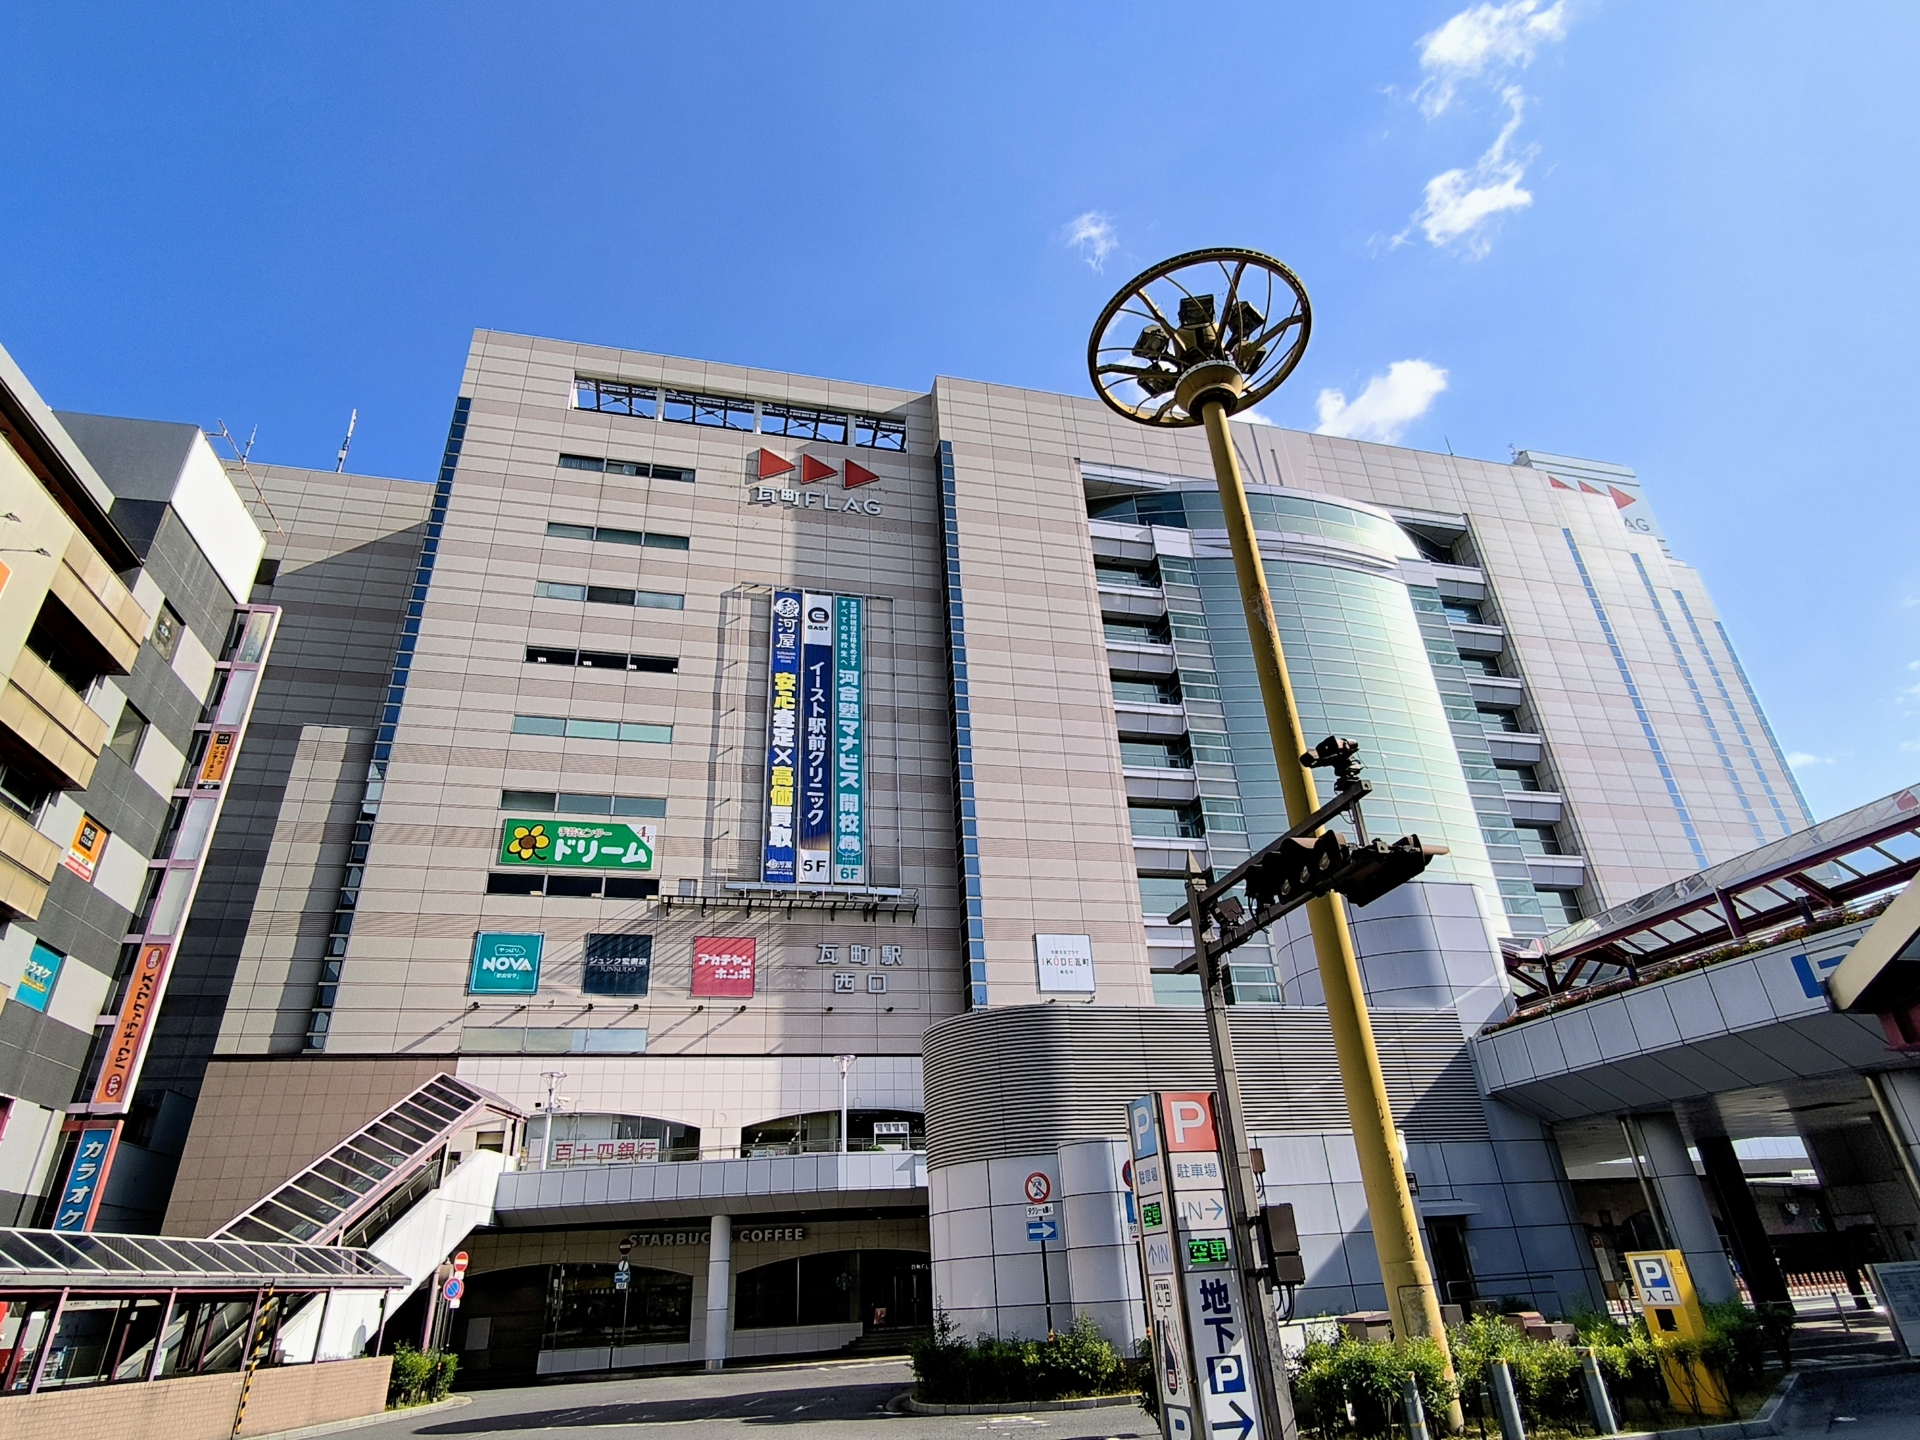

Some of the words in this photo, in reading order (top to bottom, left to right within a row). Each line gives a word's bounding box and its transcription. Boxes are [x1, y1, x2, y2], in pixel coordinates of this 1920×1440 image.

[757, 485, 882, 515] 瓦町FLAG
[1624, 516, 1650, 532] AG
[774, 597, 800, 649] 駿河屋
[838, 669, 860, 789] 河合塾マナビス
[807, 661, 827, 826] イースト駅前クリニック
[554, 839, 648, 863] ドリーム
[803, 860, 827, 872] 5F
[840, 868, 858, 879] 6F
[482, 957, 533, 972] NOVA
[589, 956, 648, 966] ジュンク堂書店
[698, 954, 752, 967] アカチャン
[817, 943, 903, 966] 瓦町駅
[833, 972, 888, 994] 西口
[115, 972, 155, 1069] パワードラッグワンズ
[1132, 1106, 1150, 1151] P
[1171, 1101, 1206, 1143] P
[556, 1141, 656, 1162] 百十四銀行
[1138, 1167, 1158, 1185] 駐車場
[1176, 1162, 1218, 1180] 駐車場
[61, 1141, 104, 1227] カラオケ
[1181, 1201, 1203, 1221] IN
[629, 1232, 733, 1247] STARBUC
[740, 1228, 803, 1242] COFFEE
[1189, 1237, 1229, 1264] 空車
[1638, 1261, 1663, 1287] P
[1647, 1290, 1674, 1302] 入口
[1200, 1278, 1235, 1354] 地下
[1214, 1357, 1239, 1392] P
